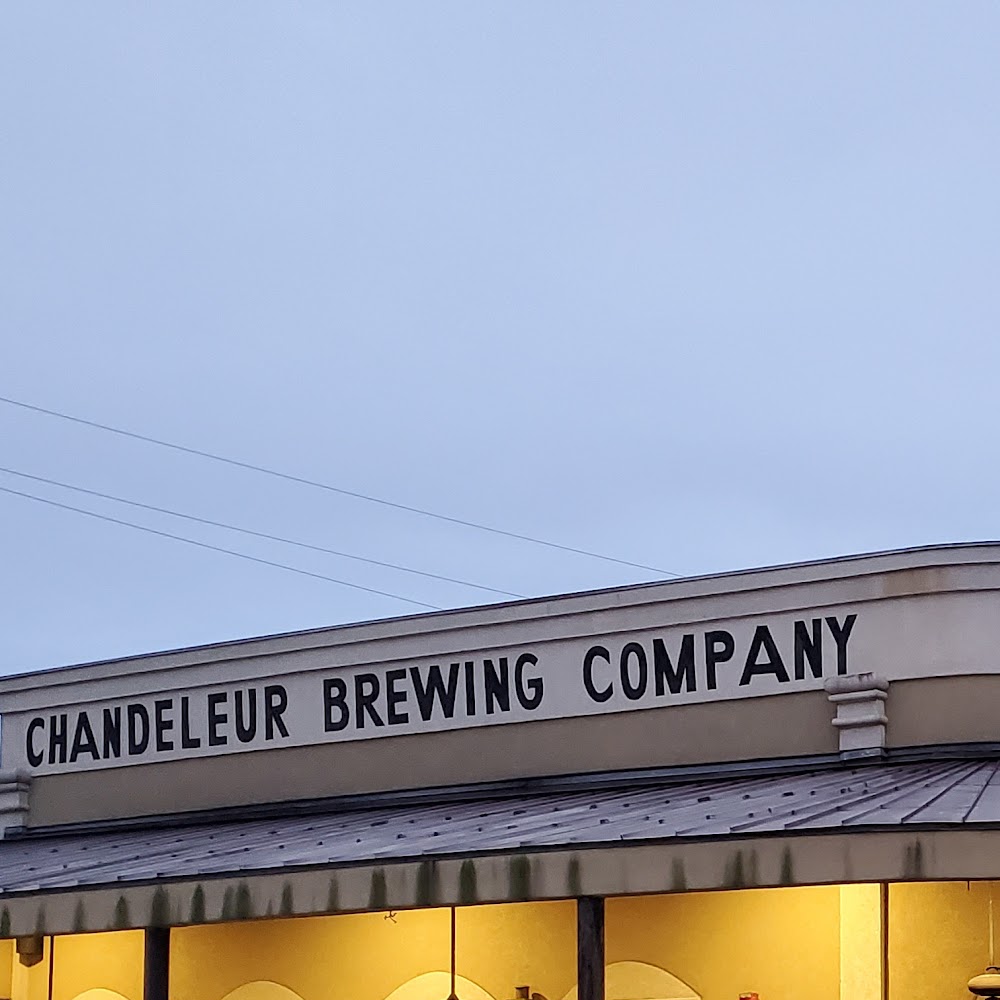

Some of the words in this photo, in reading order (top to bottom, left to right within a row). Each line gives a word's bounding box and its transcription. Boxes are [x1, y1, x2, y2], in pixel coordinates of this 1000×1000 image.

[26, 684, 290, 768] CHANDELEUR
[323, 653, 544, 733] BREWING
[582, 614, 858, 703] COMPANY
